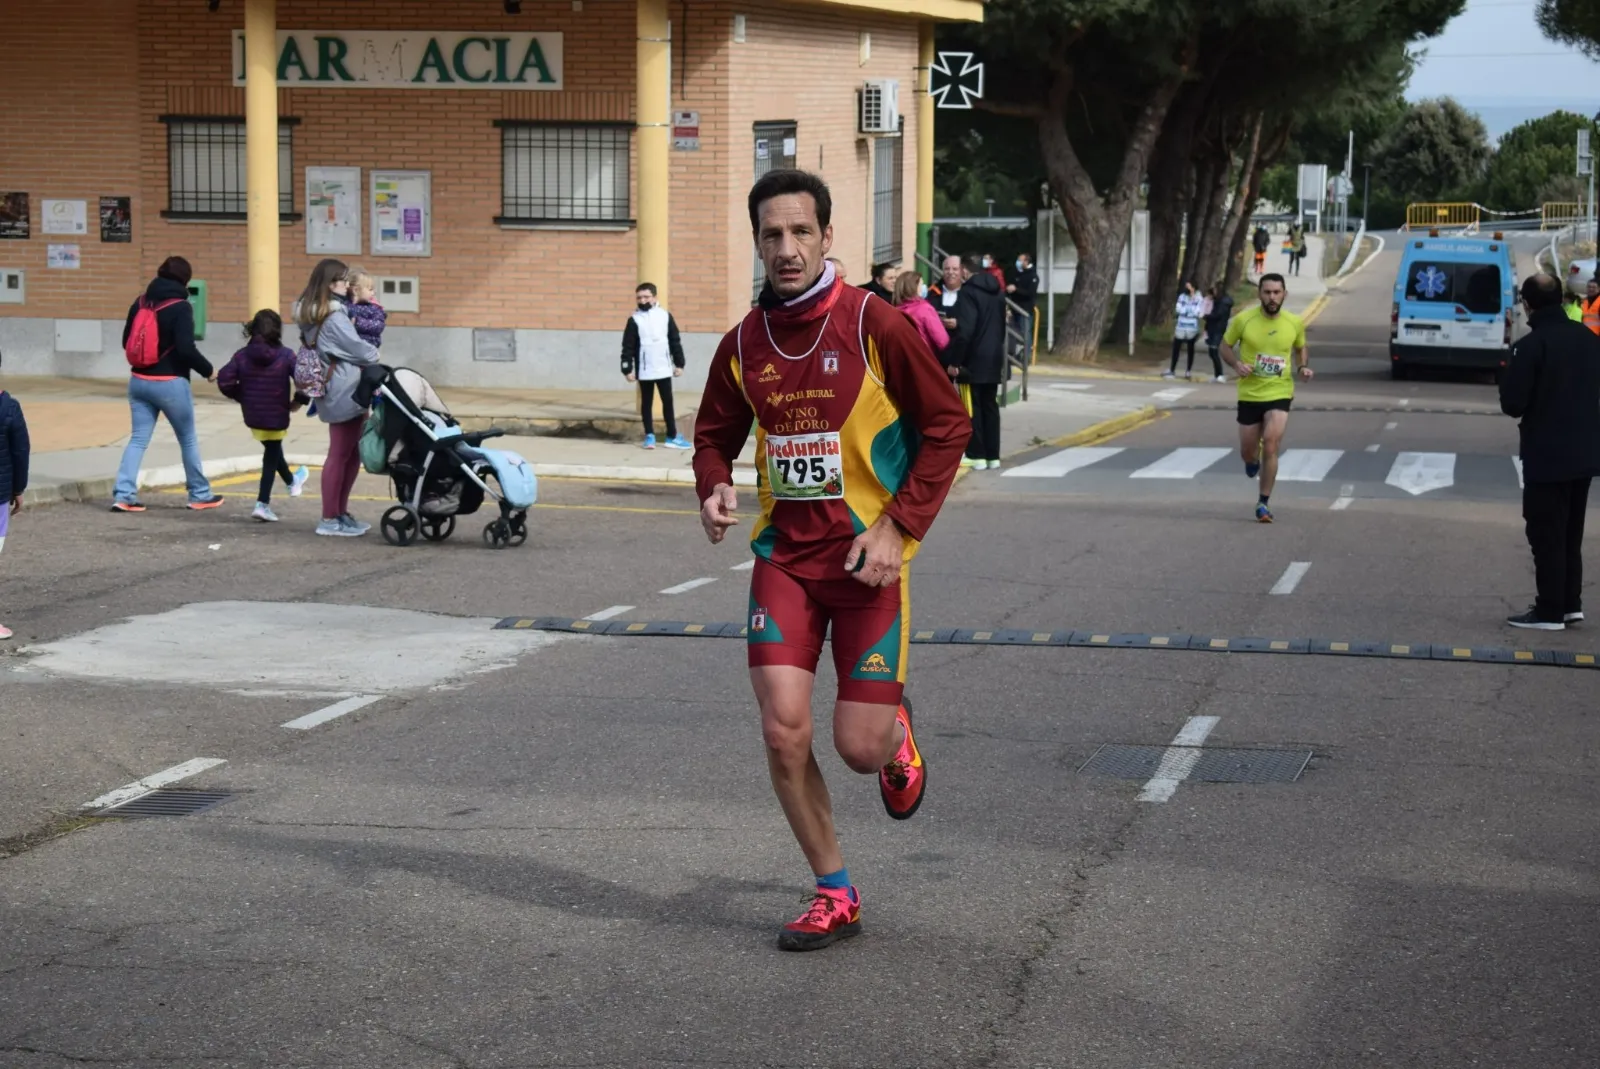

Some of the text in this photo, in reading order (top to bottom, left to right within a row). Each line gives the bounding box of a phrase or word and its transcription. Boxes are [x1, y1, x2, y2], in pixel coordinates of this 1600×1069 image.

[1261, 362, 1281, 373] 758
[806, 389, 835, 399] RURAL
[785, 407, 818, 420] VINO
[775, 419, 829, 434] DE TORO
[776, 456, 826, 484] 795
